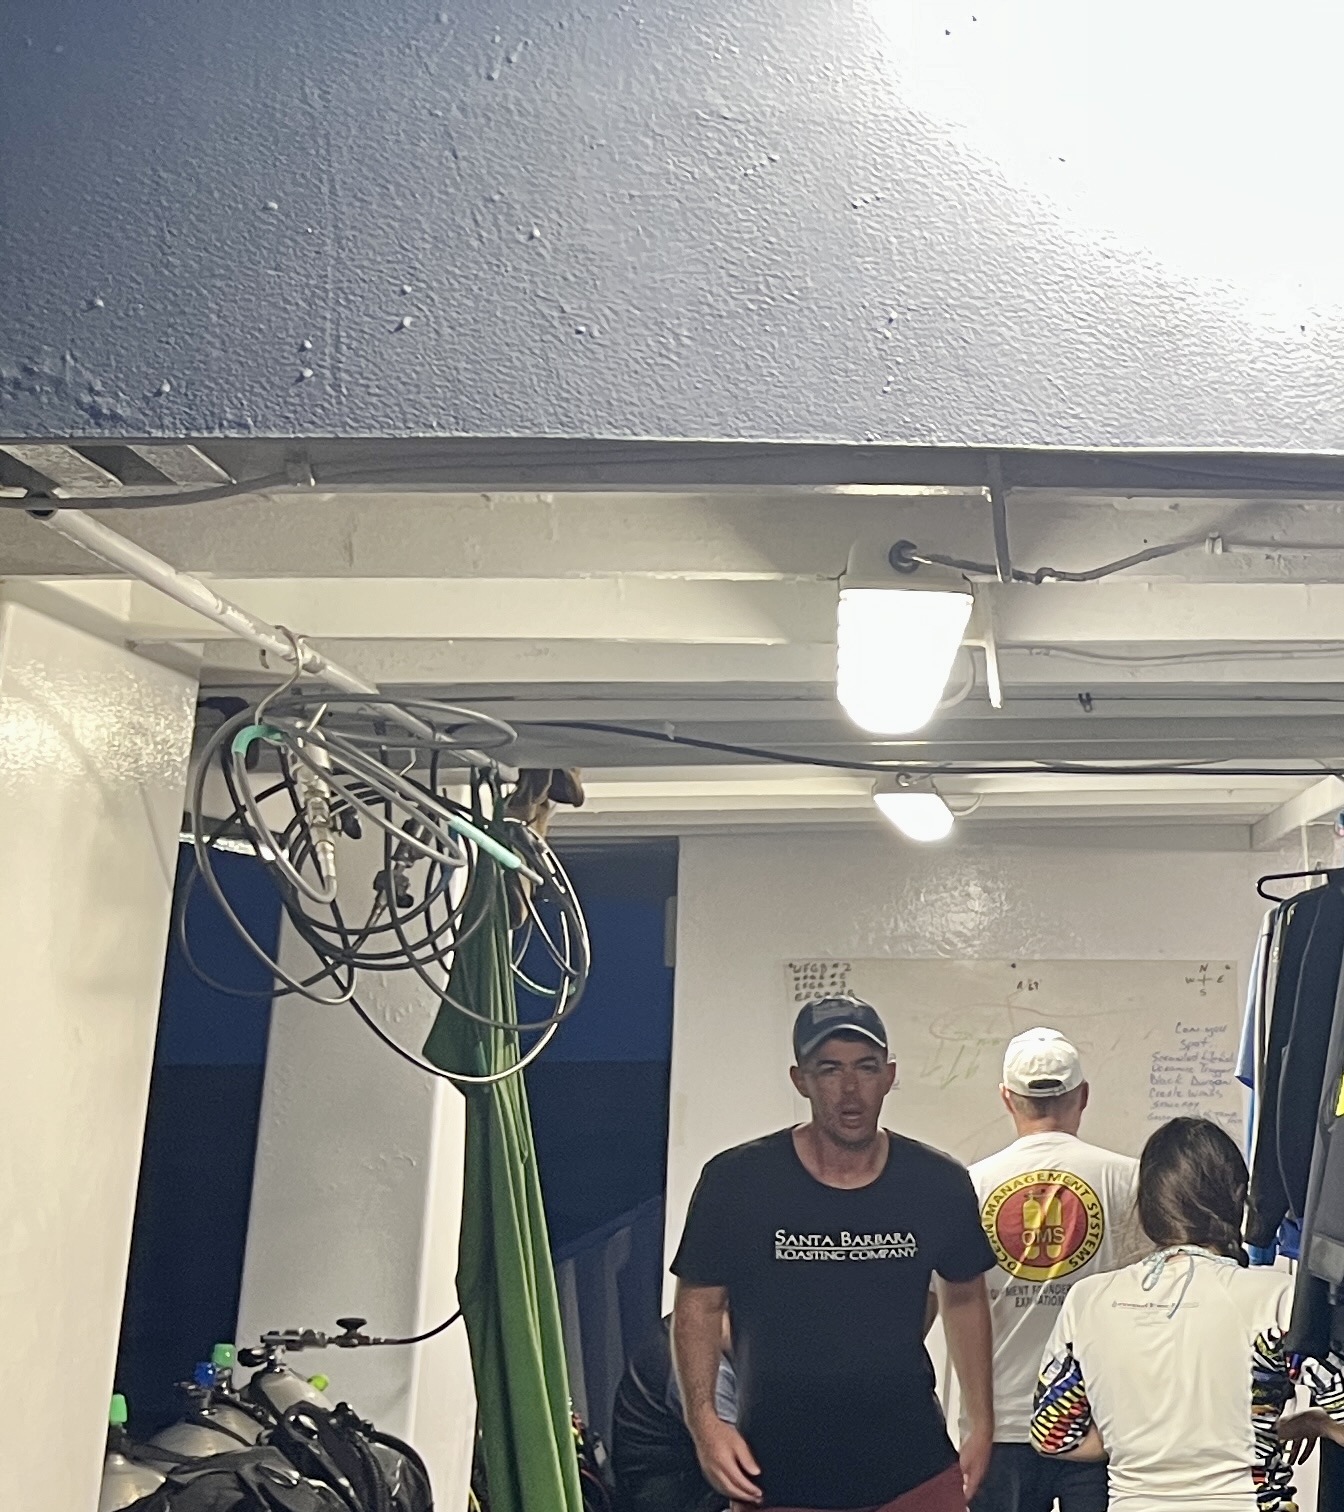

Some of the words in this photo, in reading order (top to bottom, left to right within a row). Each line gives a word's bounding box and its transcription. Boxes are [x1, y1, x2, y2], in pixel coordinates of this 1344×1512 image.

[985, 1173, 1090, 1217] MANAGEMENT
[1068, 1201, 1101, 1269] SYSTEMS
[775, 1229, 835, 1246] SANTA
[840, 1231, 916, 1246] BARBARA
[1021, 1226, 1066, 1247] OMS
[775, 1250, 846, 1261] ROASTING
[849, 1247, 918, 1260] COMPANY
